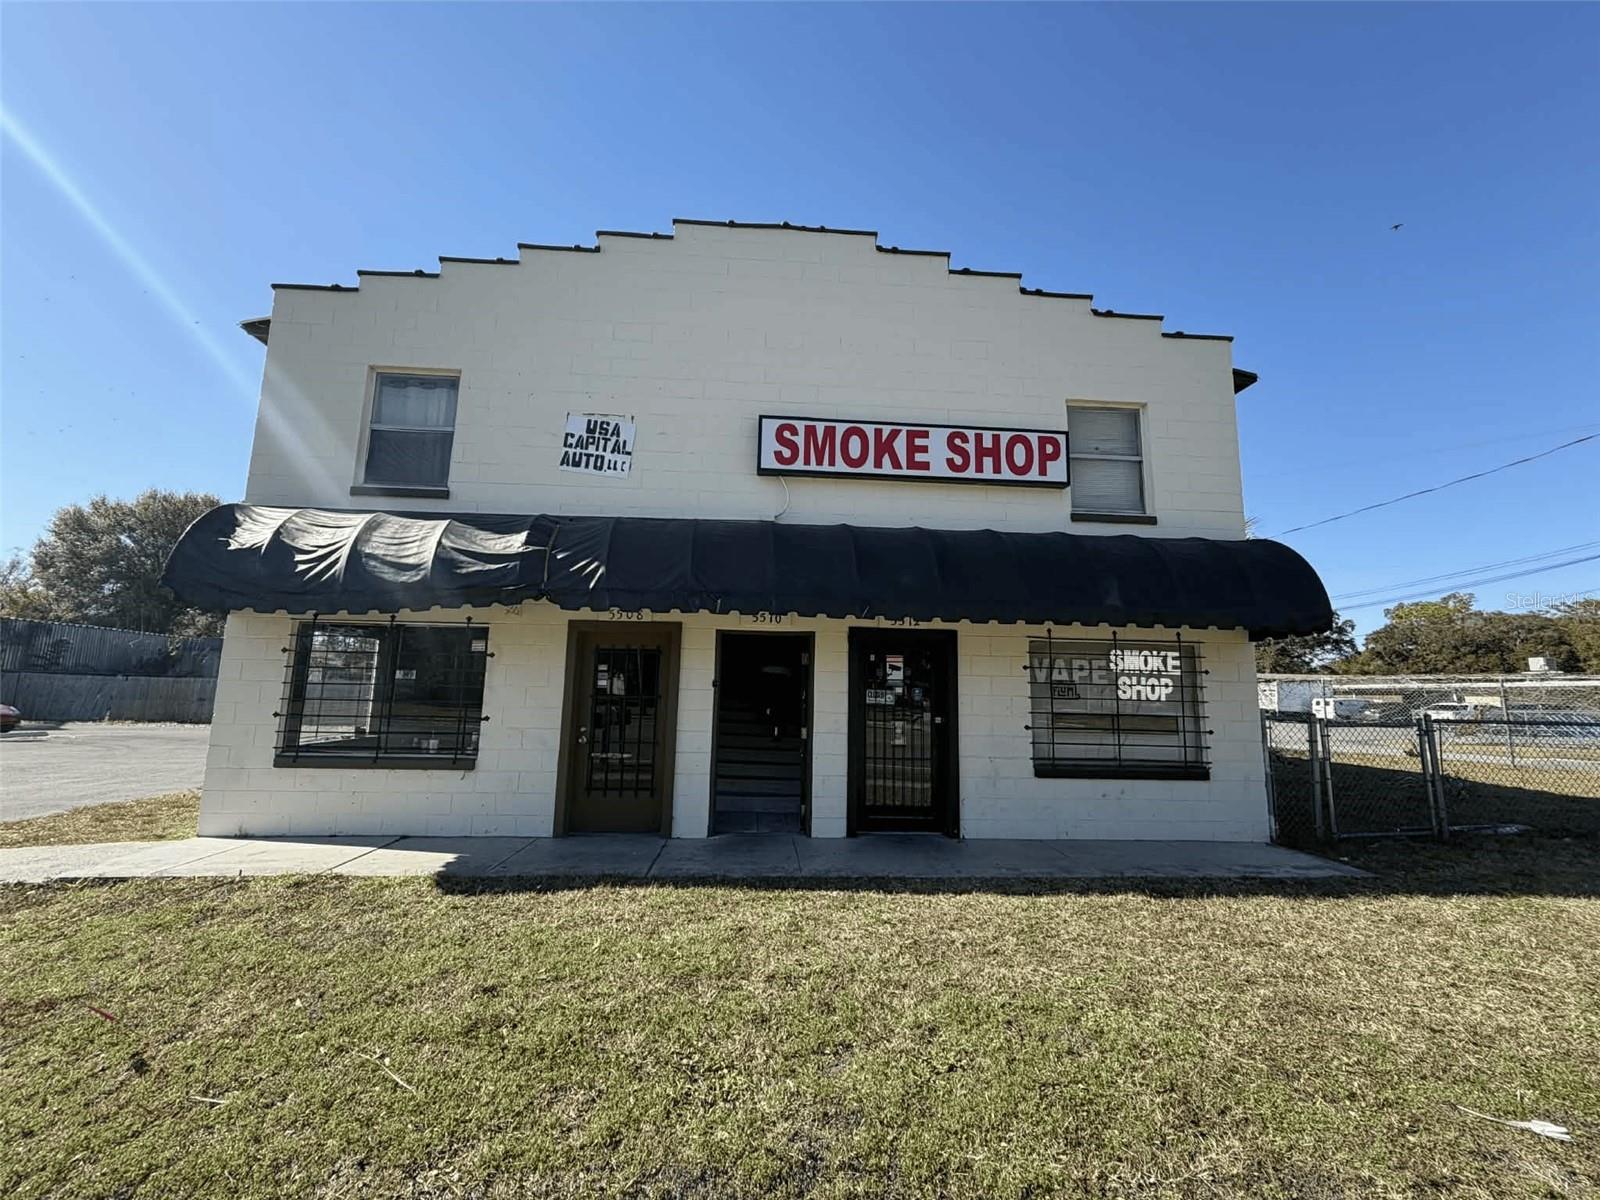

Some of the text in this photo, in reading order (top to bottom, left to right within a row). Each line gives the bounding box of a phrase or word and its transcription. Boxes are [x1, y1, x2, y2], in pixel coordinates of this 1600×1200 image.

[585, 418, 621, 438] USA
[563, 432, 632, 456] CAPITAL
[773, 422, 1061, 476] SMOKE SHOP
[1033, 657, 1108, 685] VAPE
[1109, 649, 1182, 676] SMOKE
[1117, 676, 1174, 701] SHOP
